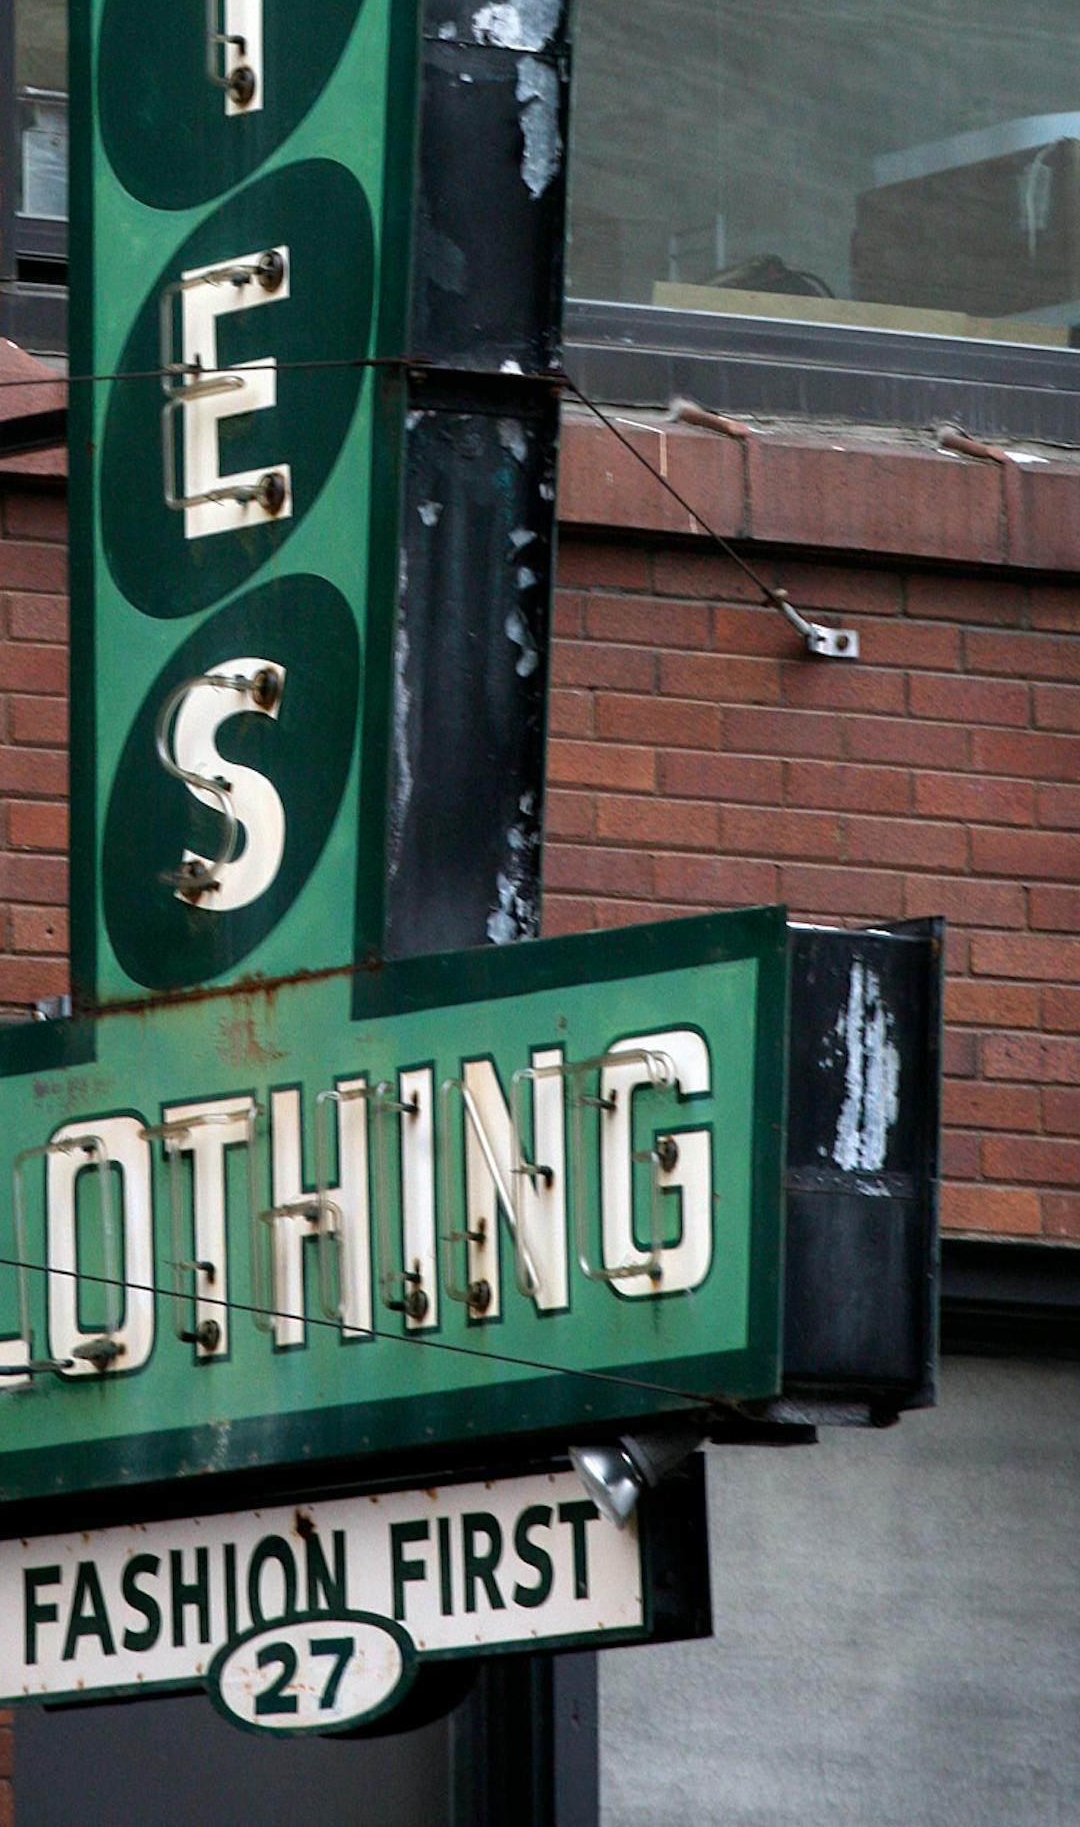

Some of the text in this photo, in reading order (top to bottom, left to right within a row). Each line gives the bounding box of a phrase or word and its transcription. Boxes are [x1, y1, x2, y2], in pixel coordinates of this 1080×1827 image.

[22, 1499, 602, 1666] FASHION FIRST
[253, 1635, 357, 1717] 27
